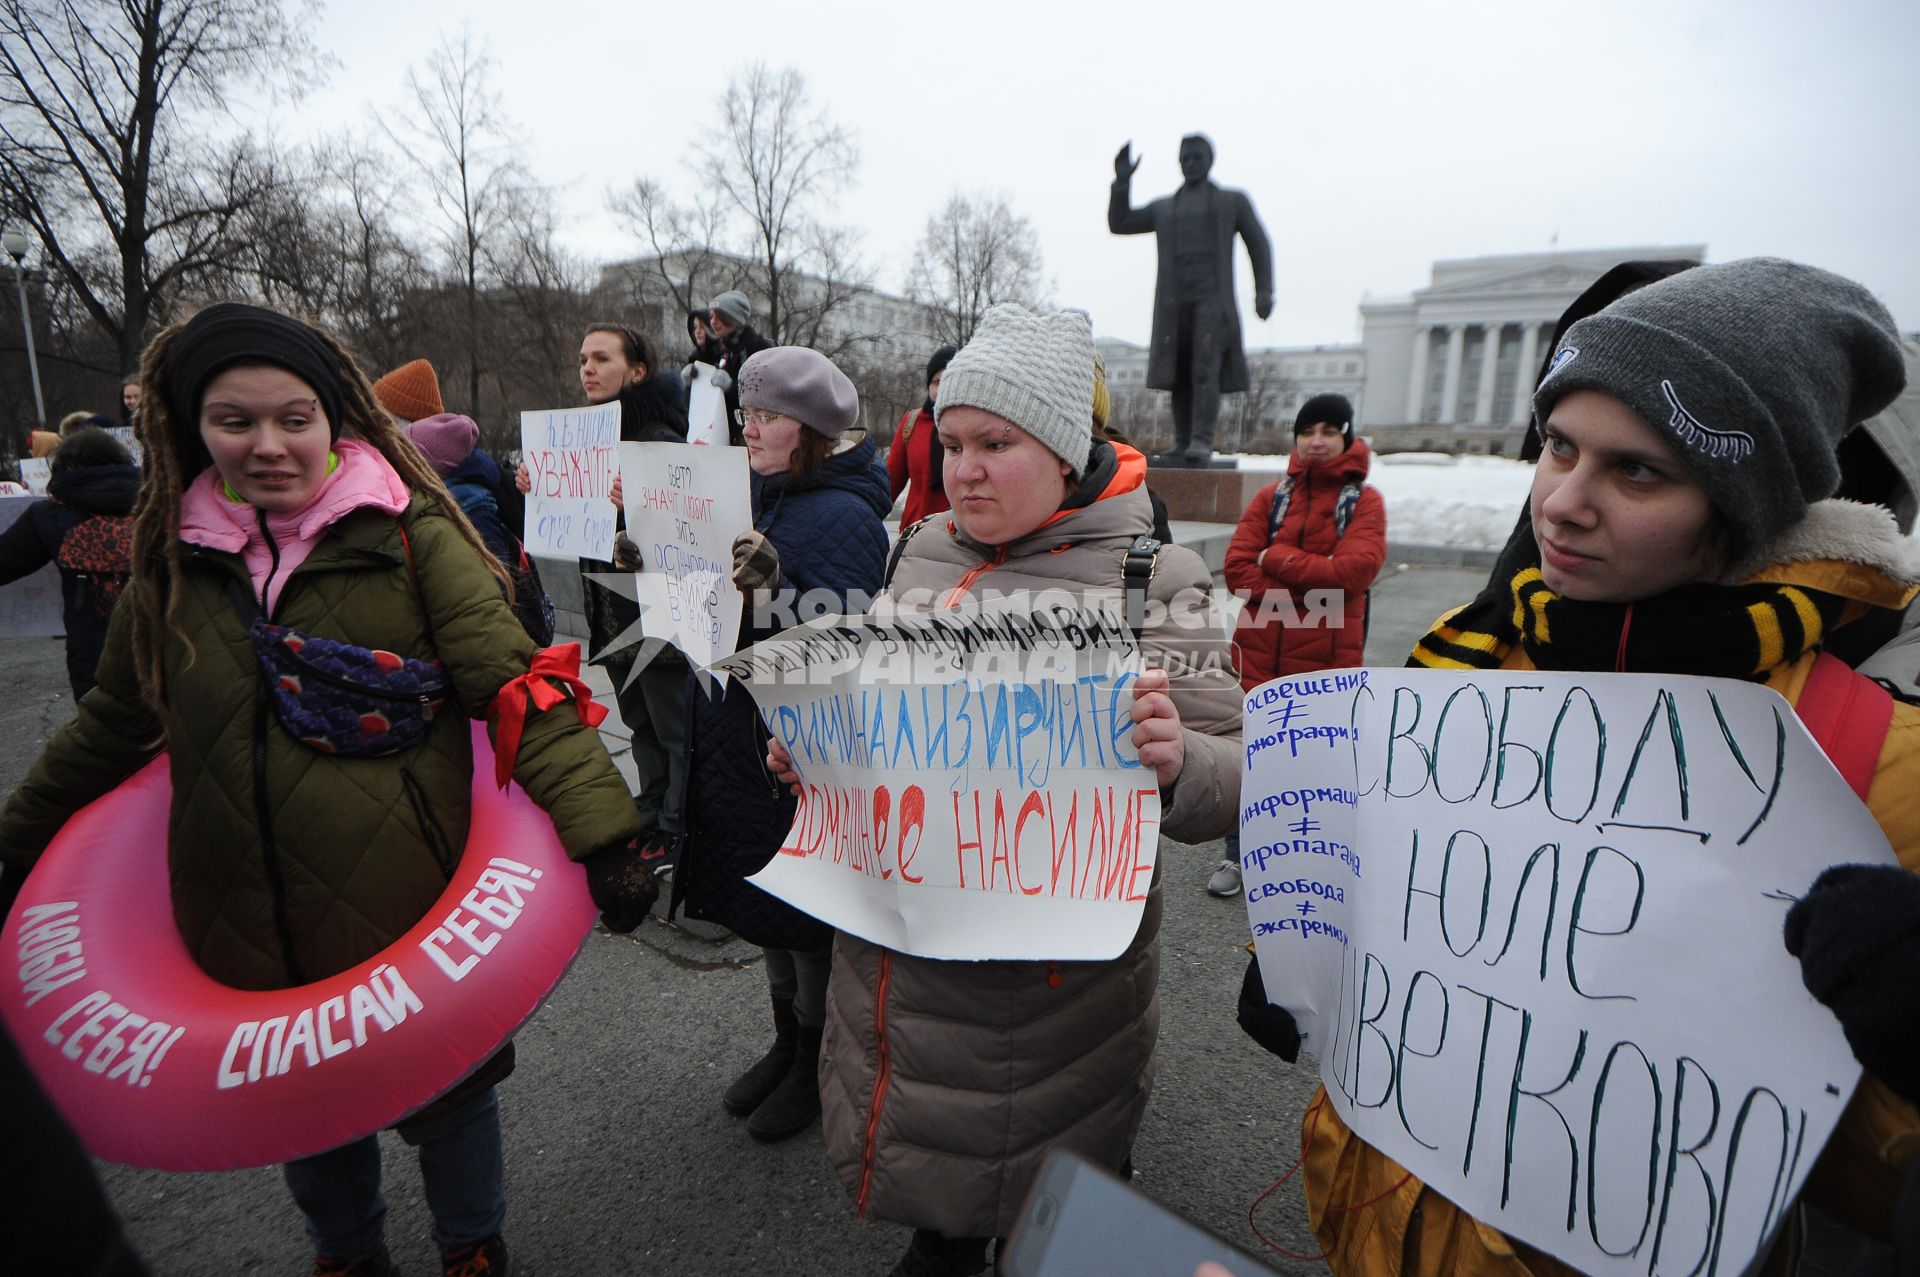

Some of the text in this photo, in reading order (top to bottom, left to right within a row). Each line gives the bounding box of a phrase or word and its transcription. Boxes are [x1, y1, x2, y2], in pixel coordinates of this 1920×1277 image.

[951, 786, 1158, 901] НАСИЛИЕ
[1351, 683, 1786, 846] СВОБОДУ
[17, 900, 187, 1088] ЛЮБИ СЕБЯ!
[217, 856, 544, 1090] СПАСАЙ СЕБЯ!
